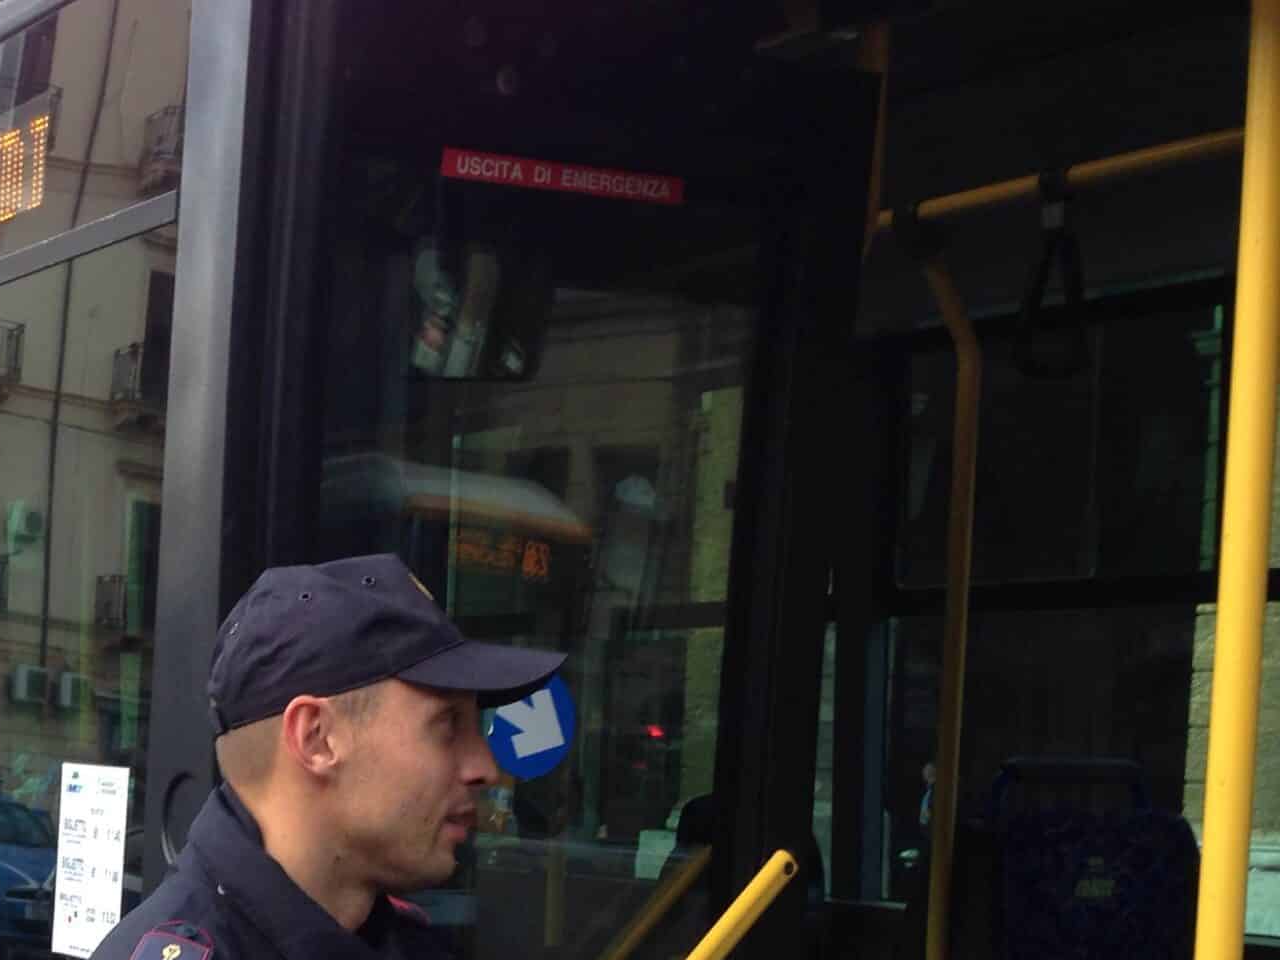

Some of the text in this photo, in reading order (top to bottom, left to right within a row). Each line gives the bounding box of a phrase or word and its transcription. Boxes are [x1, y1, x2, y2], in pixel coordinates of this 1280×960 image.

[456, 153, 672, 200] USCITA DI EMERGENZA
